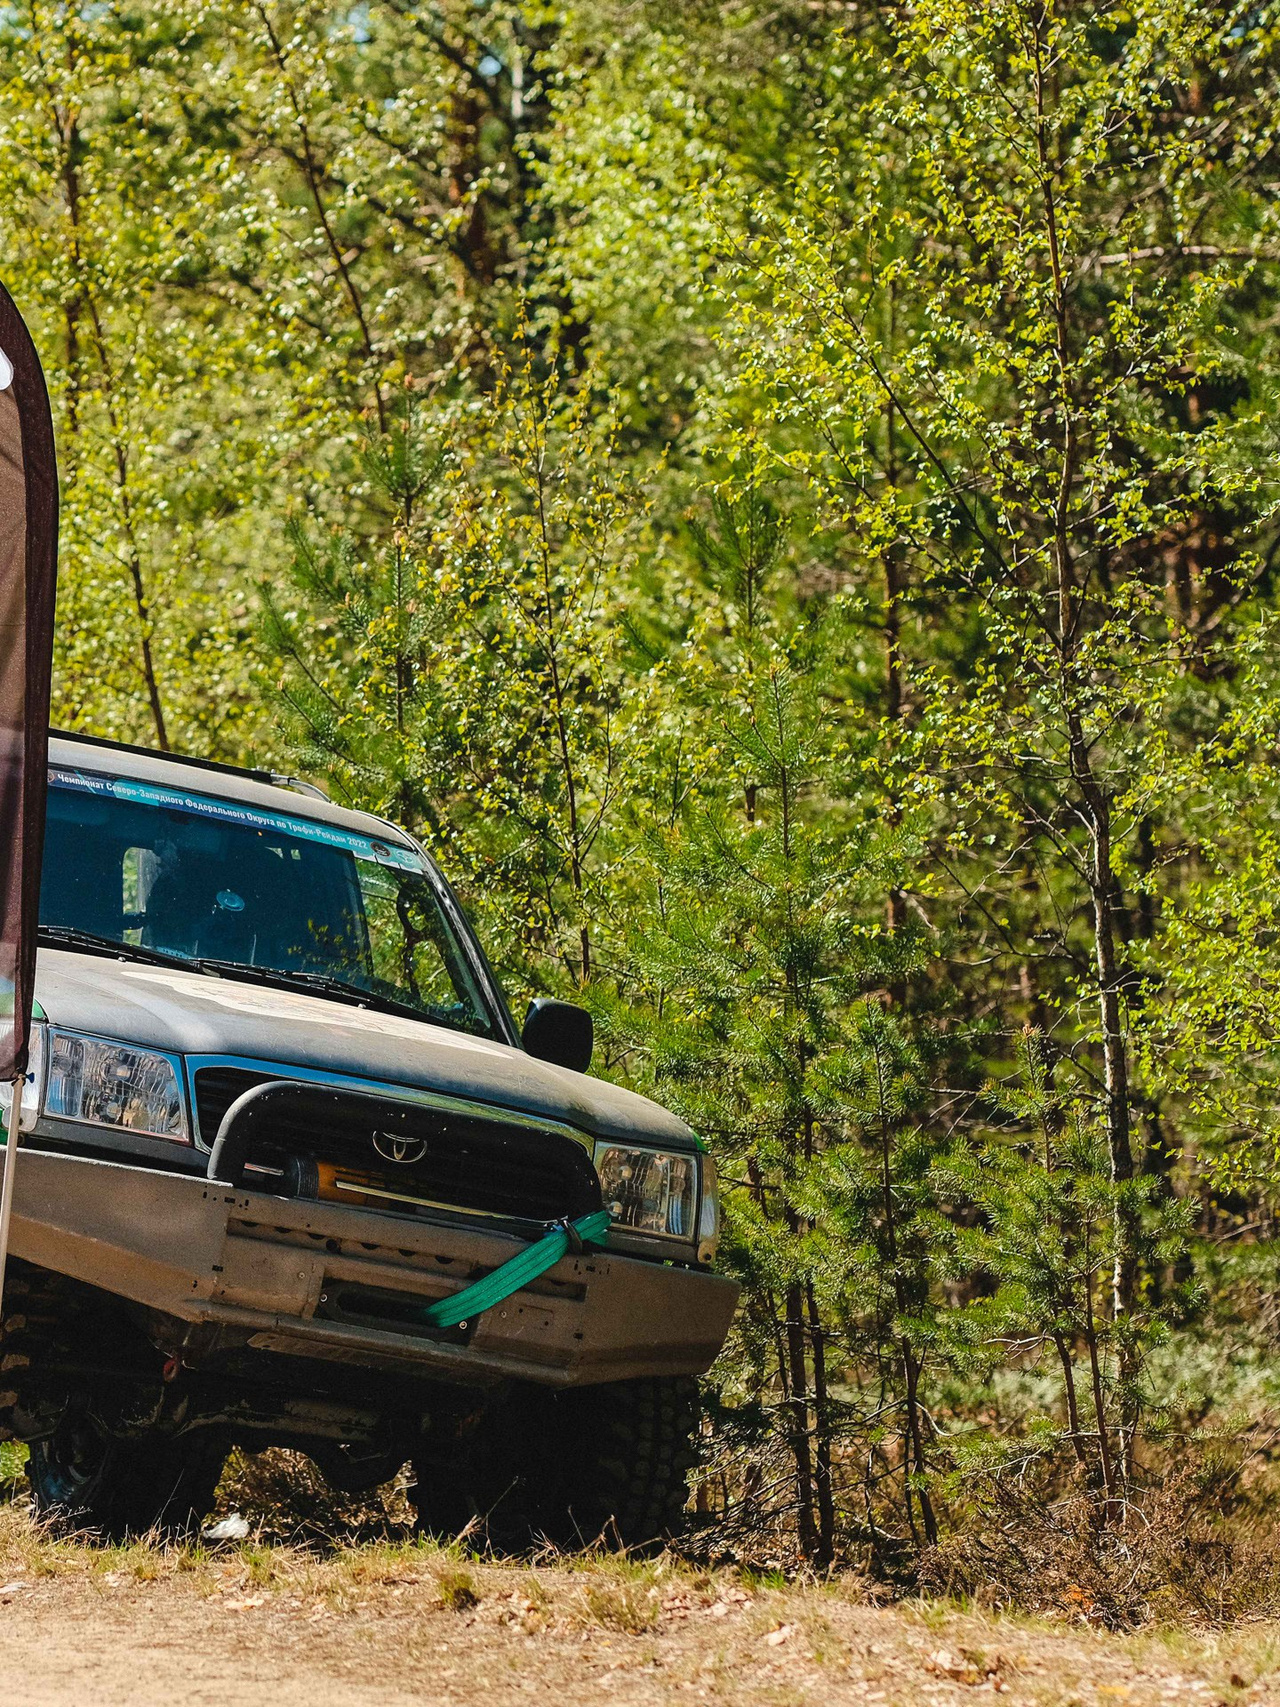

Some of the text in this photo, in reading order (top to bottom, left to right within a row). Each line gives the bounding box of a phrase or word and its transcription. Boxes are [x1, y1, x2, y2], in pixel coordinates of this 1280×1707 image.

[57, 773, 368, 850] Чемпионат Северо-Западного Федерального Округа по Трофи-Рейдам 2022
